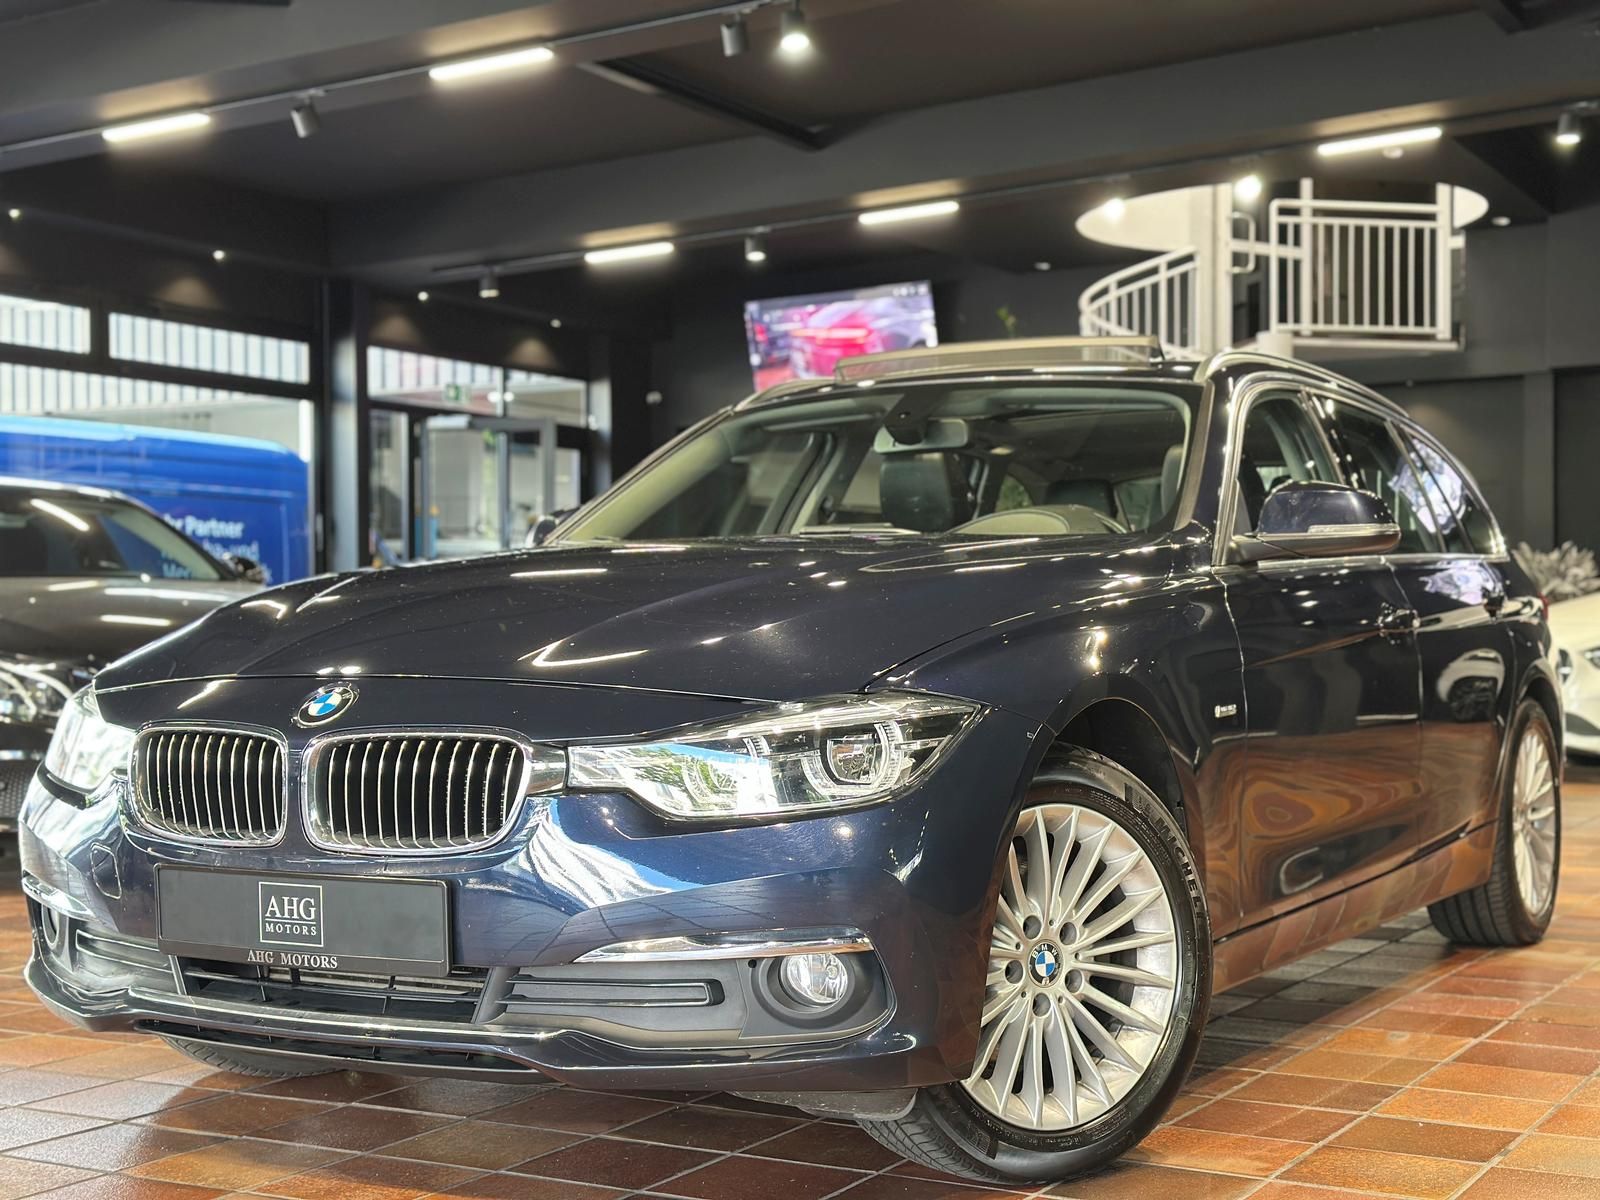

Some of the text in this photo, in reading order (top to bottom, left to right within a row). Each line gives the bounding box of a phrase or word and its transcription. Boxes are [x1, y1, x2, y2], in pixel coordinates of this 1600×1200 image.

[162, 513, 245, 539] hr Partner
[1154, 816, 1206, 920] MICHELI
[264, 895, 317, 920] AHG
[265, 922, 317, 936] MOTORS
[247, 949, 338, 969] AHG MOTORS
[1032, 943, 1058, 959] BMW
